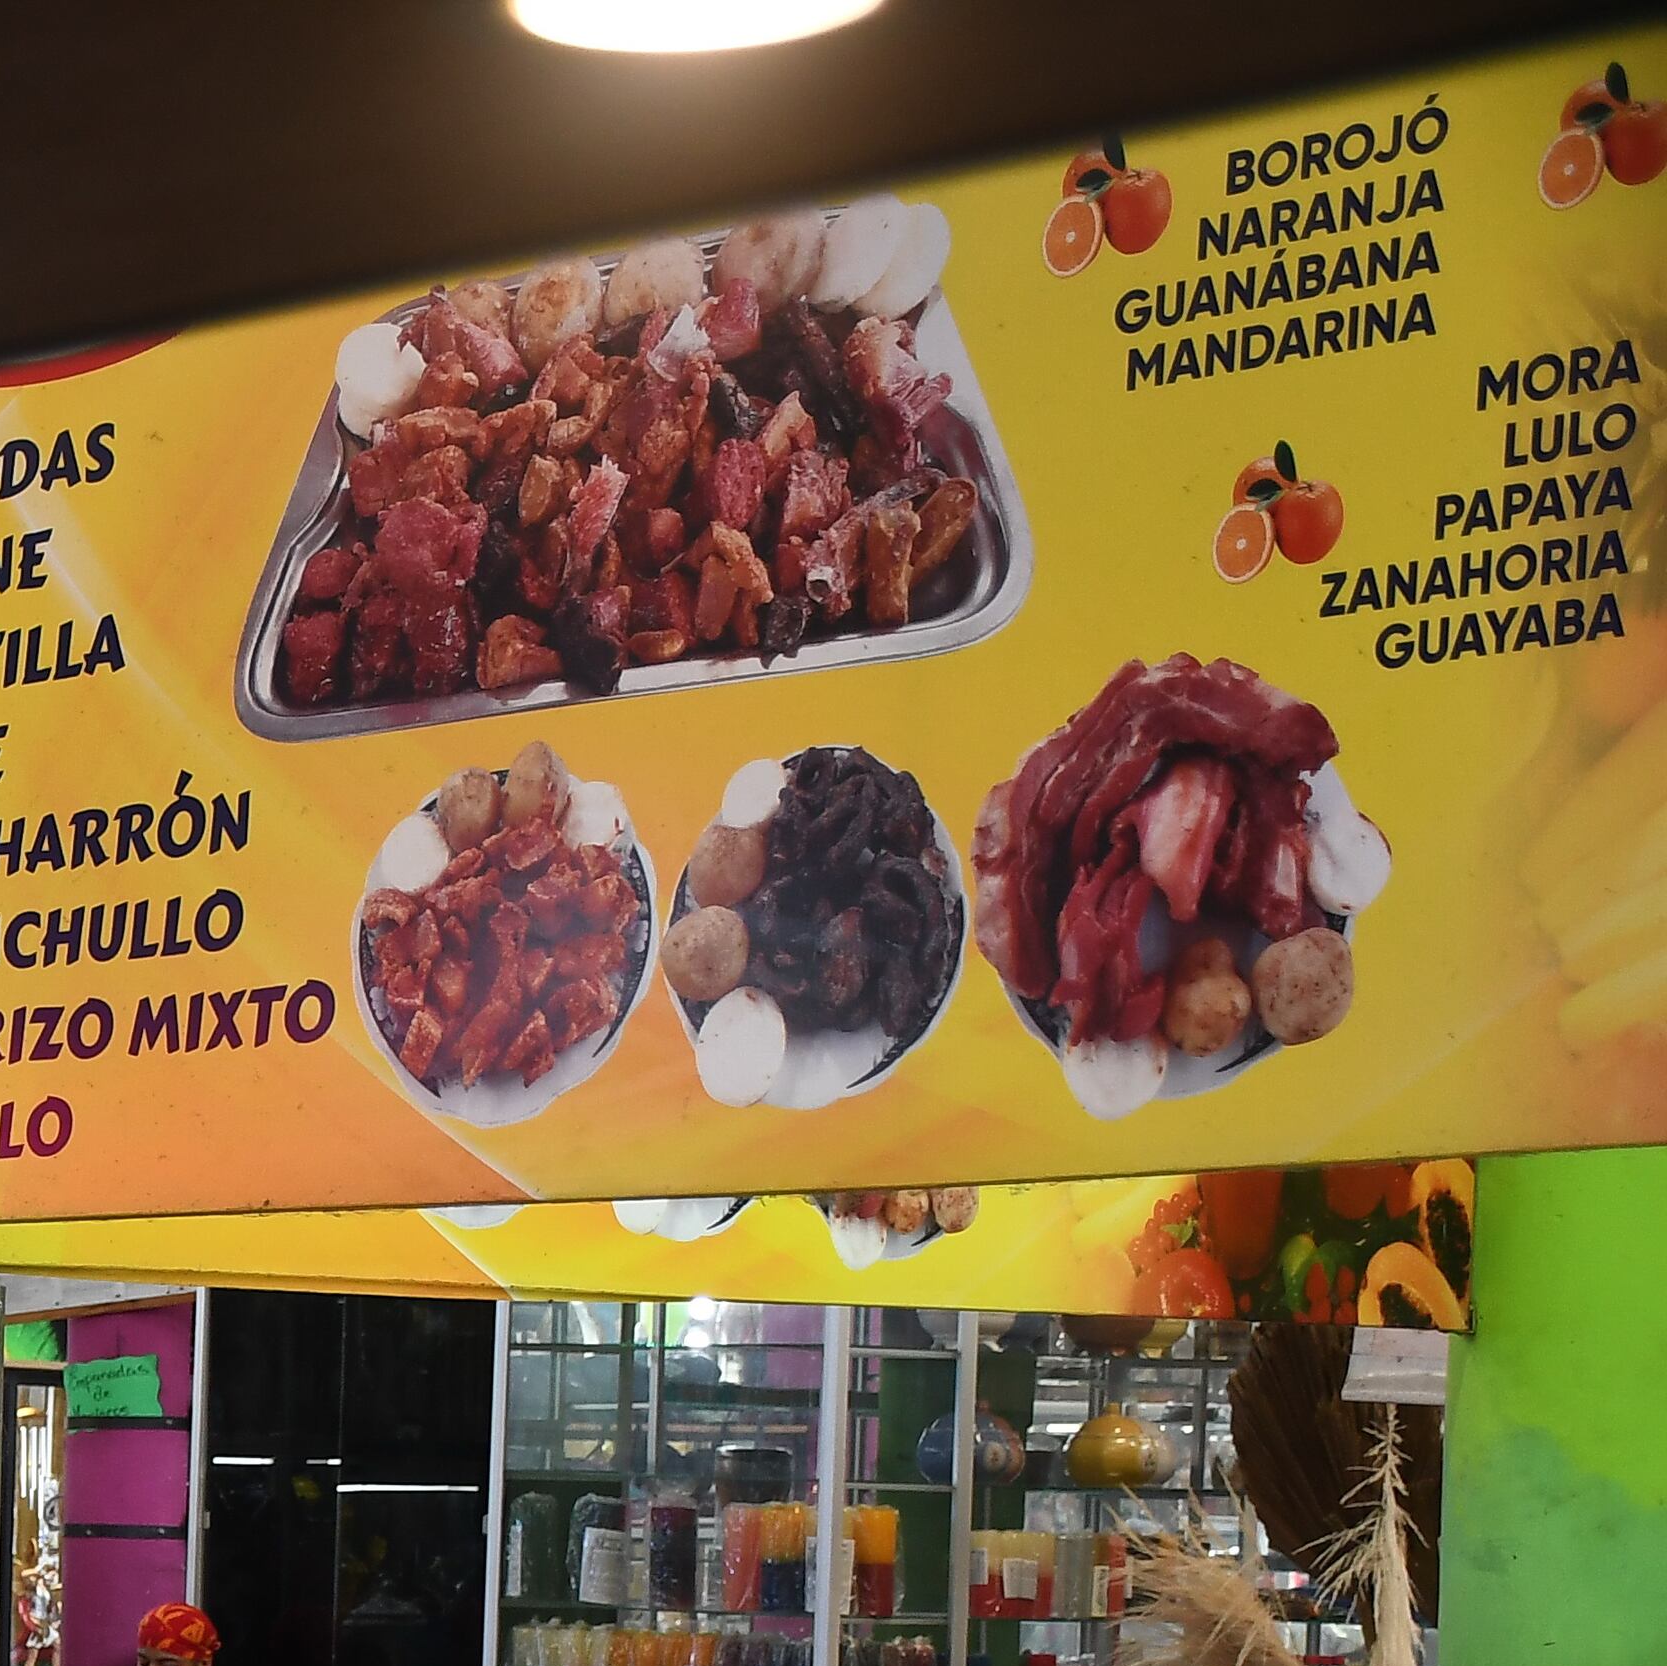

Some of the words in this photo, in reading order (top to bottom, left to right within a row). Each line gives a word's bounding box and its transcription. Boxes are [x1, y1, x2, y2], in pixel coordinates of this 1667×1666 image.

[1226, 93, 1449, 196] BOROJÓ
[1197, 168, 1444, 260] NARANJA
[1115, 231, 1441, 334] GUANÁBANA
[1126, 293, 1437, 391] MANDARINA
[1476, 339, 1640, 411] MORA
[1503, 403, 1636, 468] LULO
[1434, 467, 1633, 540] PAPAYA
[1319, 529, 1629, 618] ZANAHORIA
[1375, 594, 1624, 669] GUAYABA
[128, 979, 336, 1058] MIXTO
